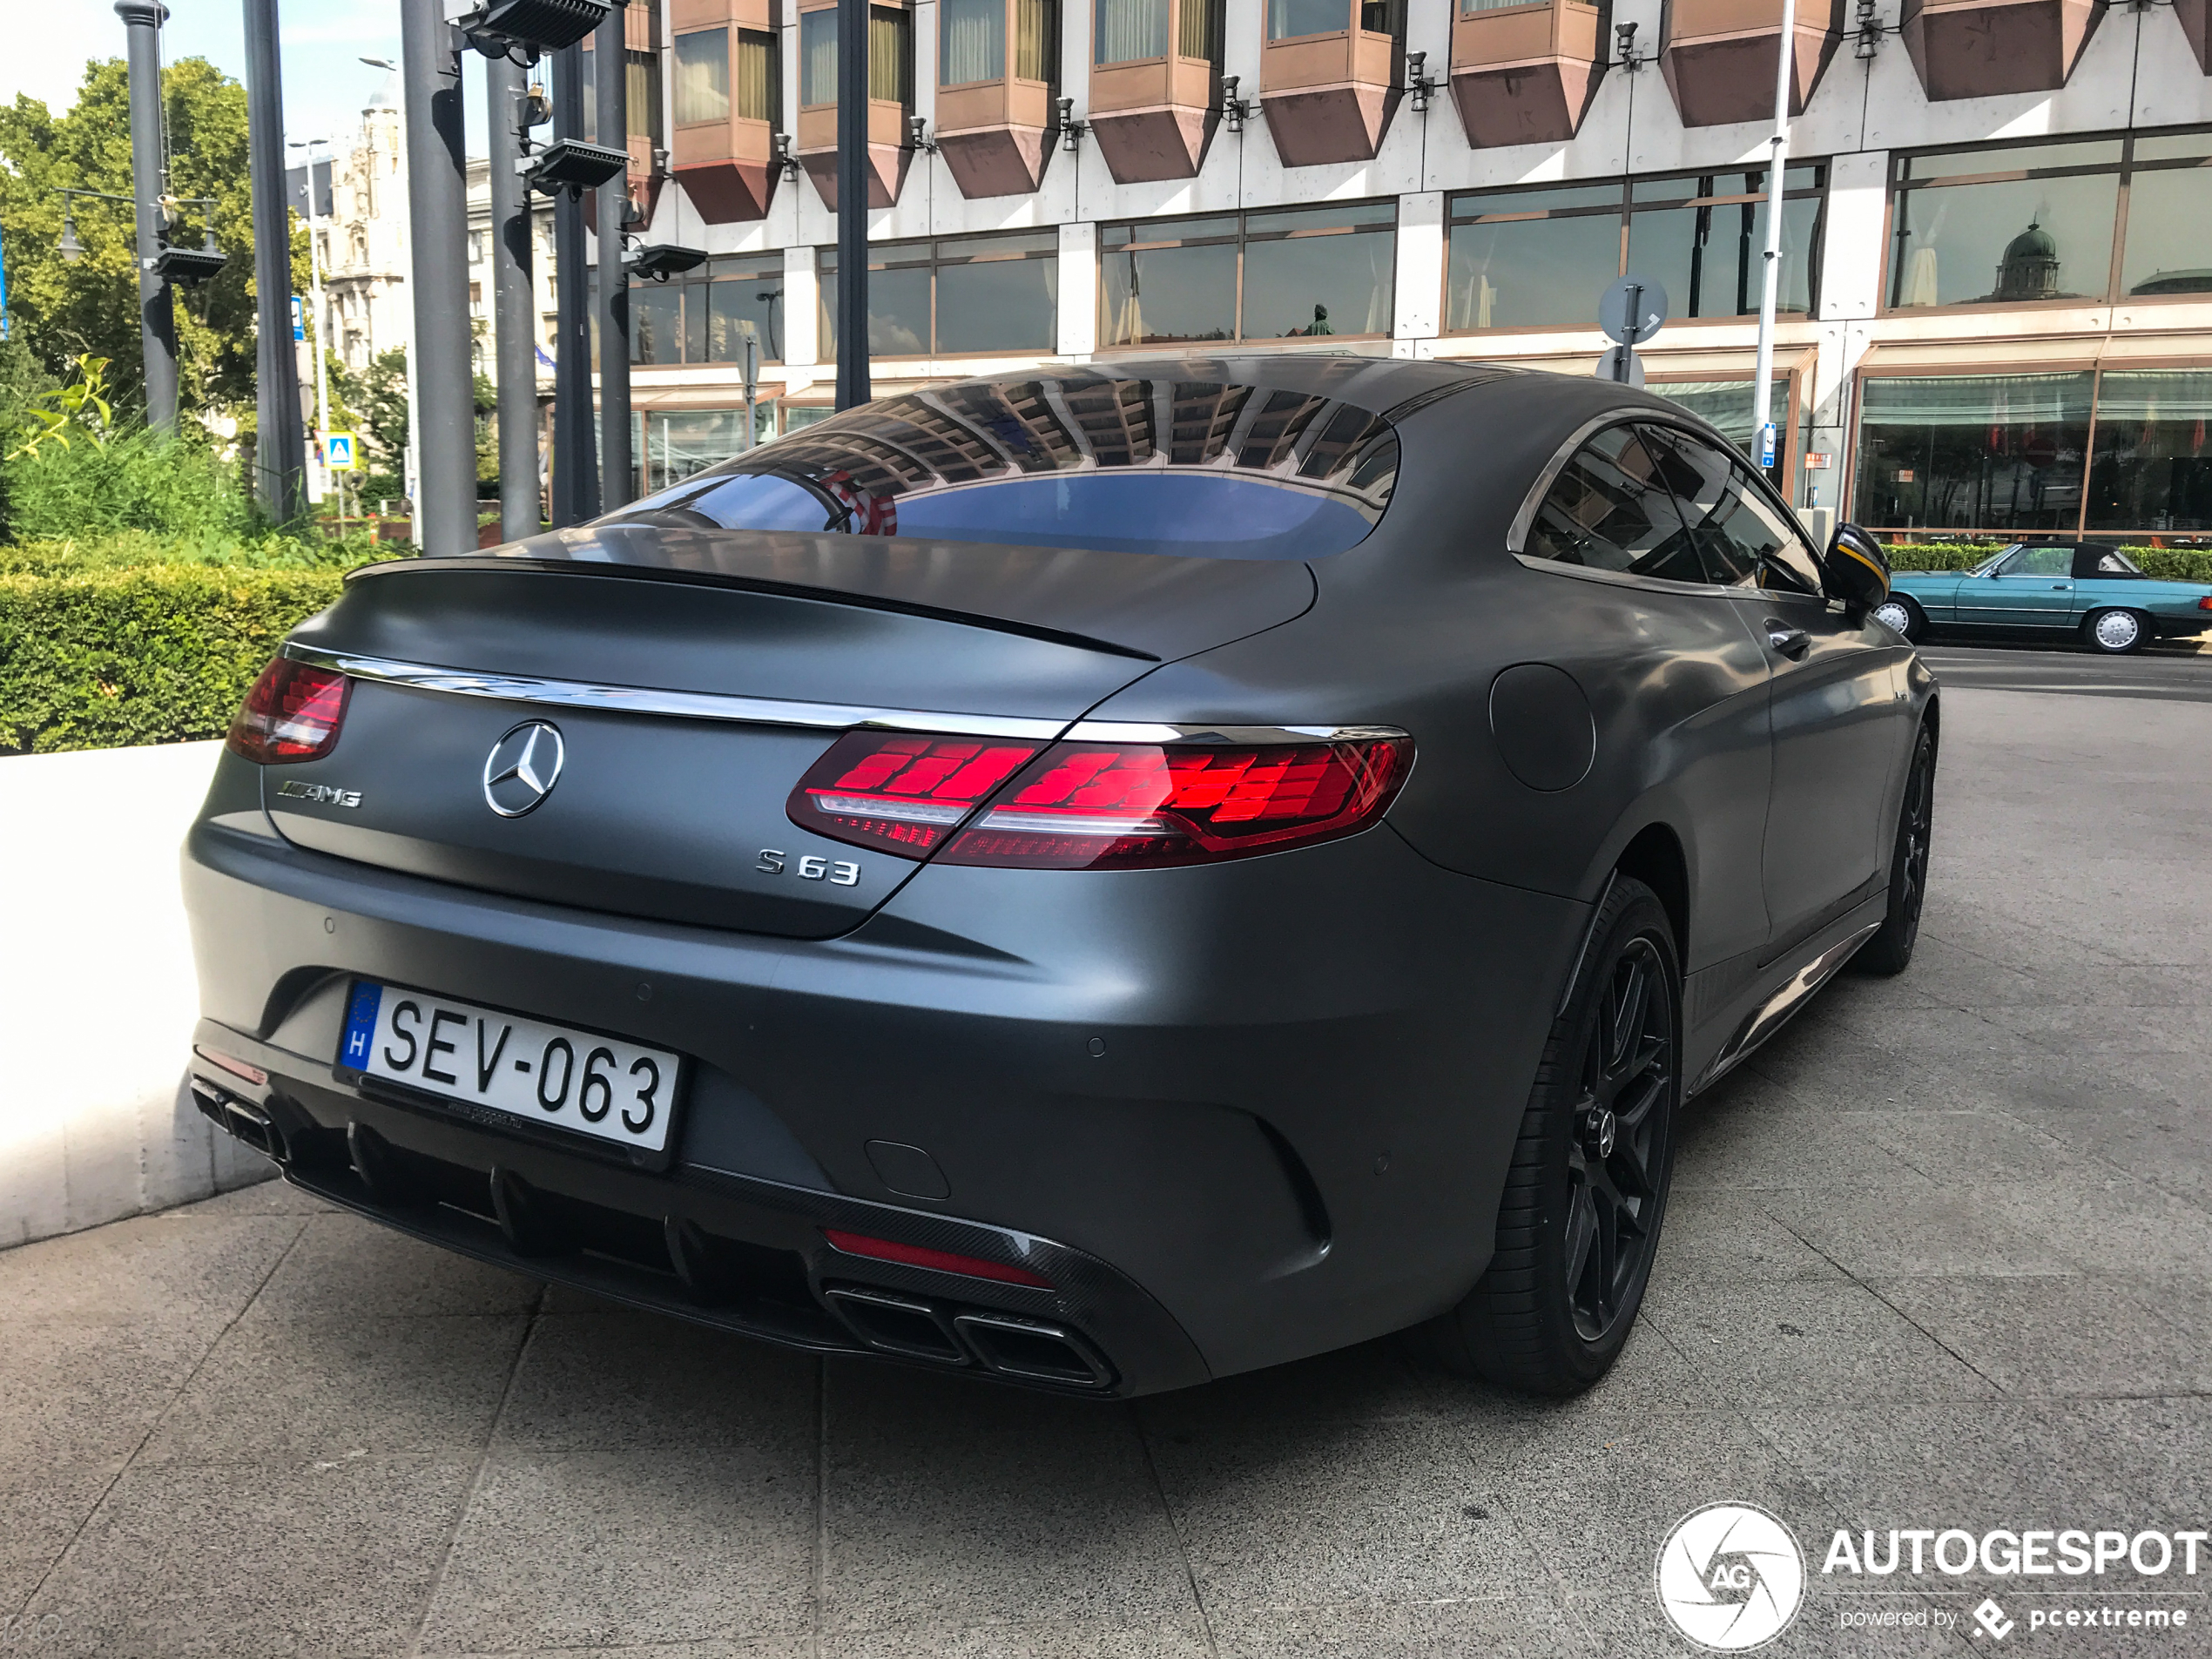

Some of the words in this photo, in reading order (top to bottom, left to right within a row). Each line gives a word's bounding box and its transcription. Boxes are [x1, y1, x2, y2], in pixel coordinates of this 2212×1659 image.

[302, 784, 362, 807] AMG
[756, 849, 786, 873] S
[798, 854, 861, 887] 63
[348, 1030, 366, 1056] H
[384, 1001, 660, 1134] SEV-063
